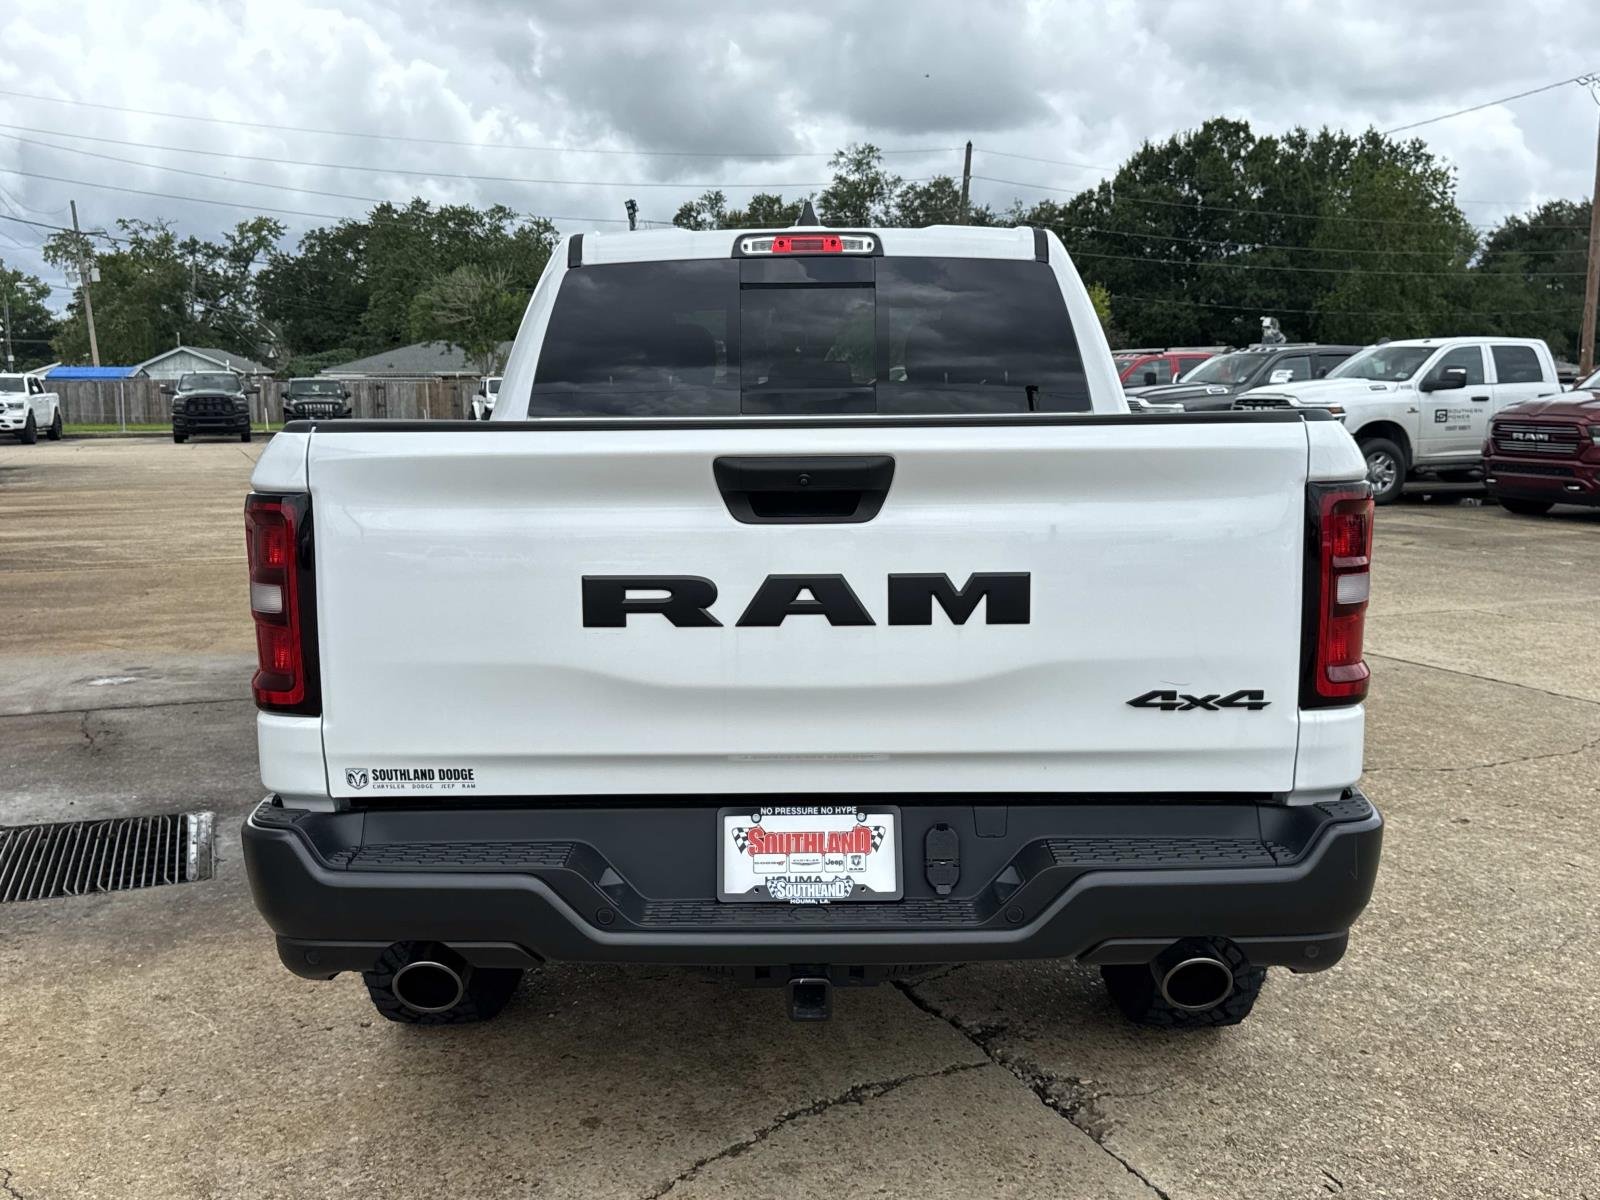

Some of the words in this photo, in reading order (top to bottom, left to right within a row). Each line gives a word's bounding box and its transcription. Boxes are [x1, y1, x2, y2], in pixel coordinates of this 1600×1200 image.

[1512, 432, 1548, 441] RAM
[581, 572, 1031, 628] RAM
[1125, 689, 1272, 711] 4x4
[372, 769, 435, 781] SOUTHLAND
[438, 769, 474, 780] DODGE
[775, 807, 818, 815] PRESSURE
[748, 826, 872, 855] SOUTHLAND
[776, 881, 845, 898] SOUTHLAND
